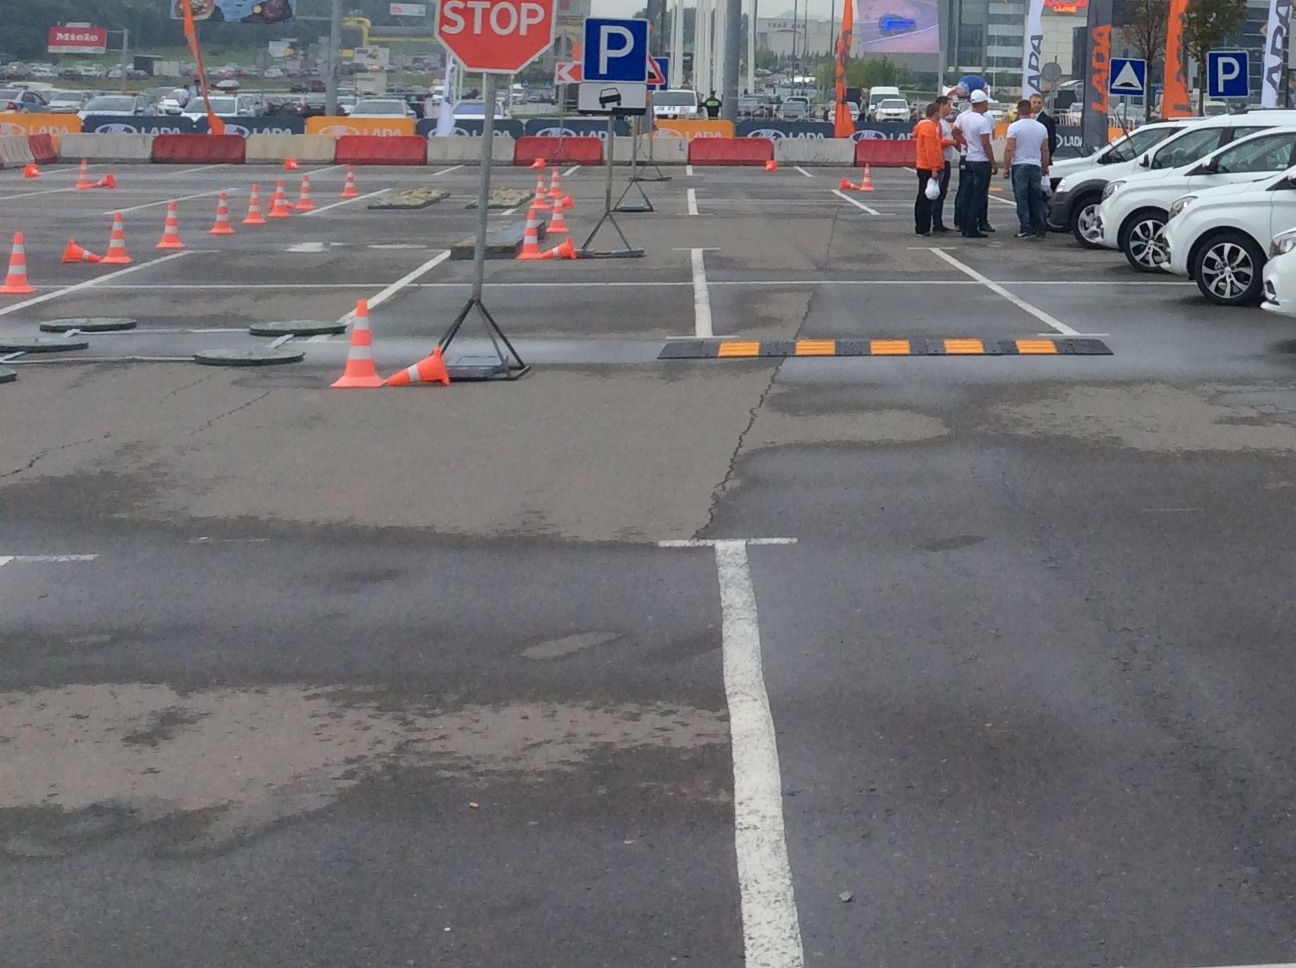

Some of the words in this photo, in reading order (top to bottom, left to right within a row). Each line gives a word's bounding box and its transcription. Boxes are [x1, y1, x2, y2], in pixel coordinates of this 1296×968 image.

[440, 0, 546, 36] STOP
[55, 32, 99, 42] Miele
[598, 24, 635, 75] P
[1027, 34, 1044, 94] ADA
[1217, 56, 1241, 93] P
